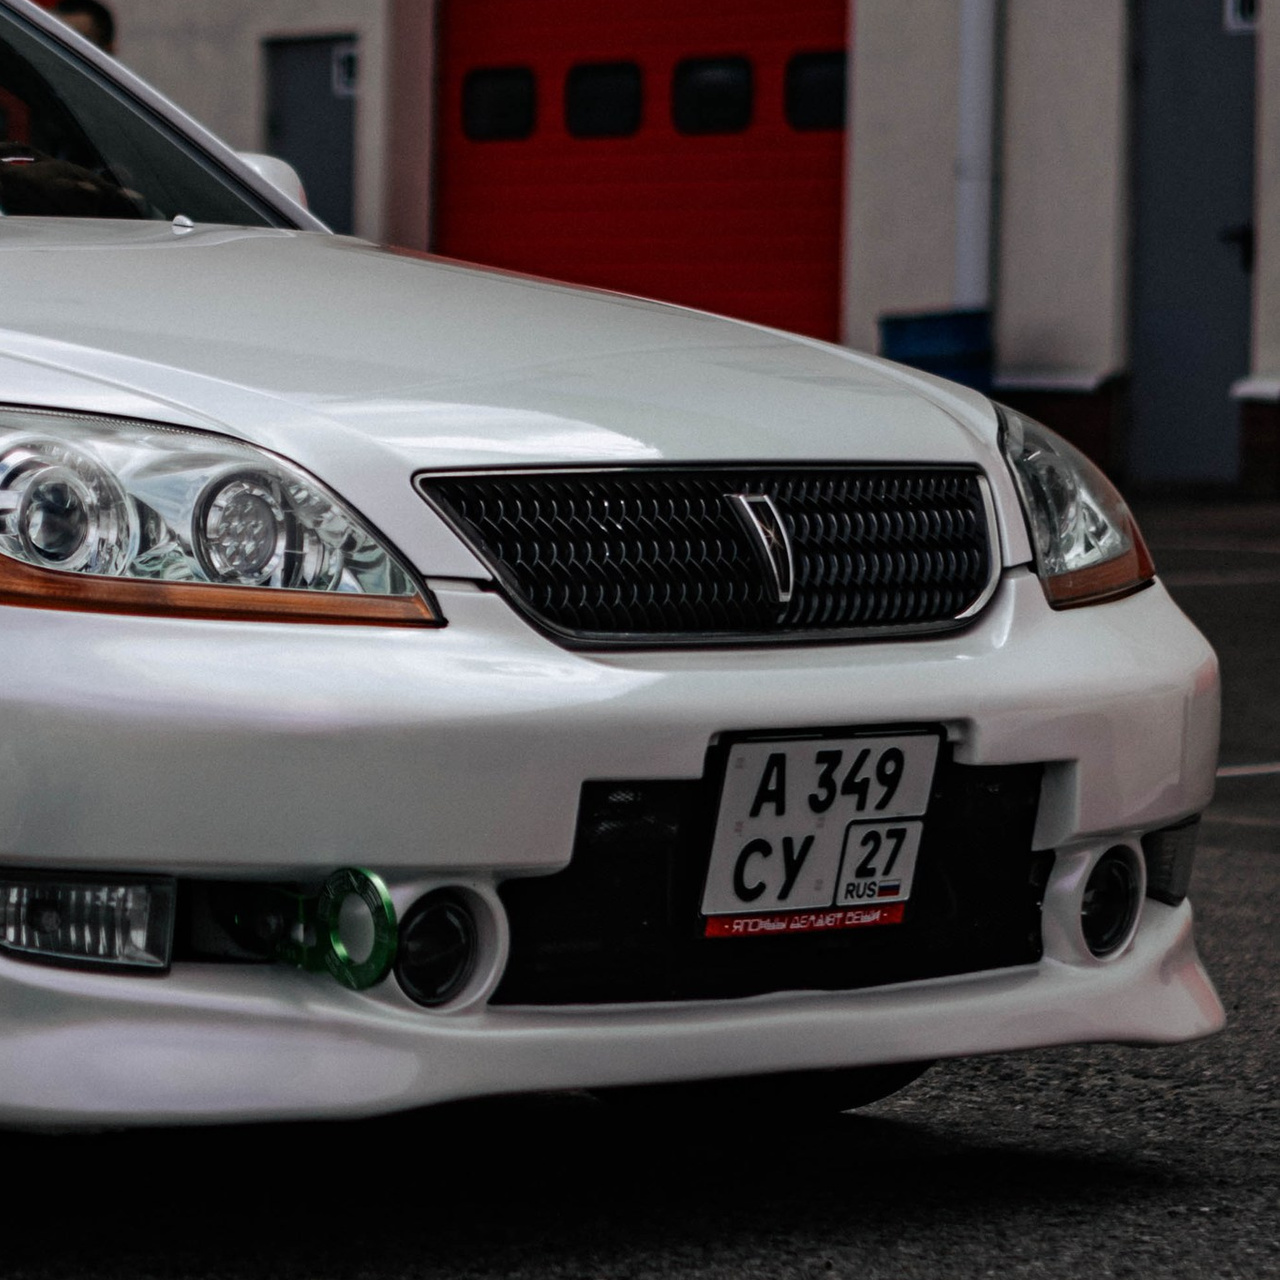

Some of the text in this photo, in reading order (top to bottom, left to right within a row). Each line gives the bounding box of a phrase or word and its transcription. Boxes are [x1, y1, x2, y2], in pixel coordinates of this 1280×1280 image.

[807, 746, 906, 814] 349
[854, 827, 908, 879] 27
[844, 881, 877, 900] RUS
